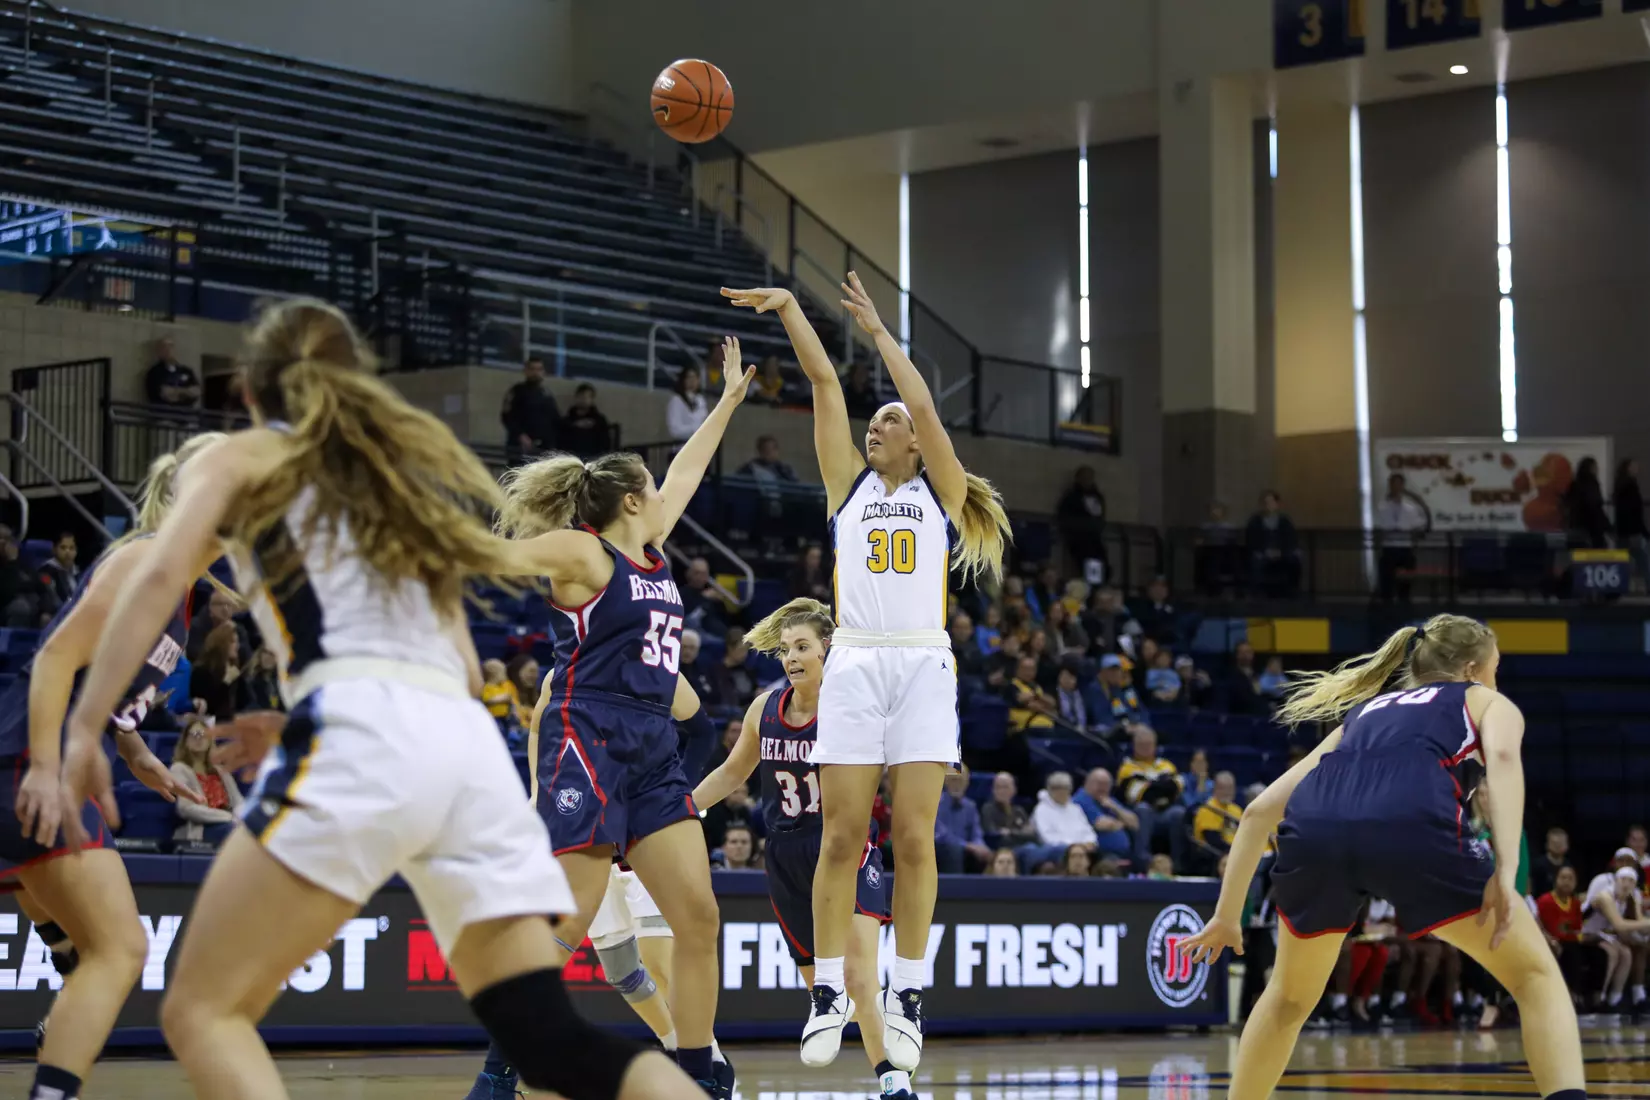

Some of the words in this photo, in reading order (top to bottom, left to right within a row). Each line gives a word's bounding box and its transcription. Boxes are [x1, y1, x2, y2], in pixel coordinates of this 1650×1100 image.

[1300, 4, 1323, 47] 3
[867, 528, 916, 574] 30
[1583, 565, 1620, 589] 106
[641, 609, 683, 675] 55
[775, 770, 820, 817] 31
[956, 923, 1119, 987] FRESH
